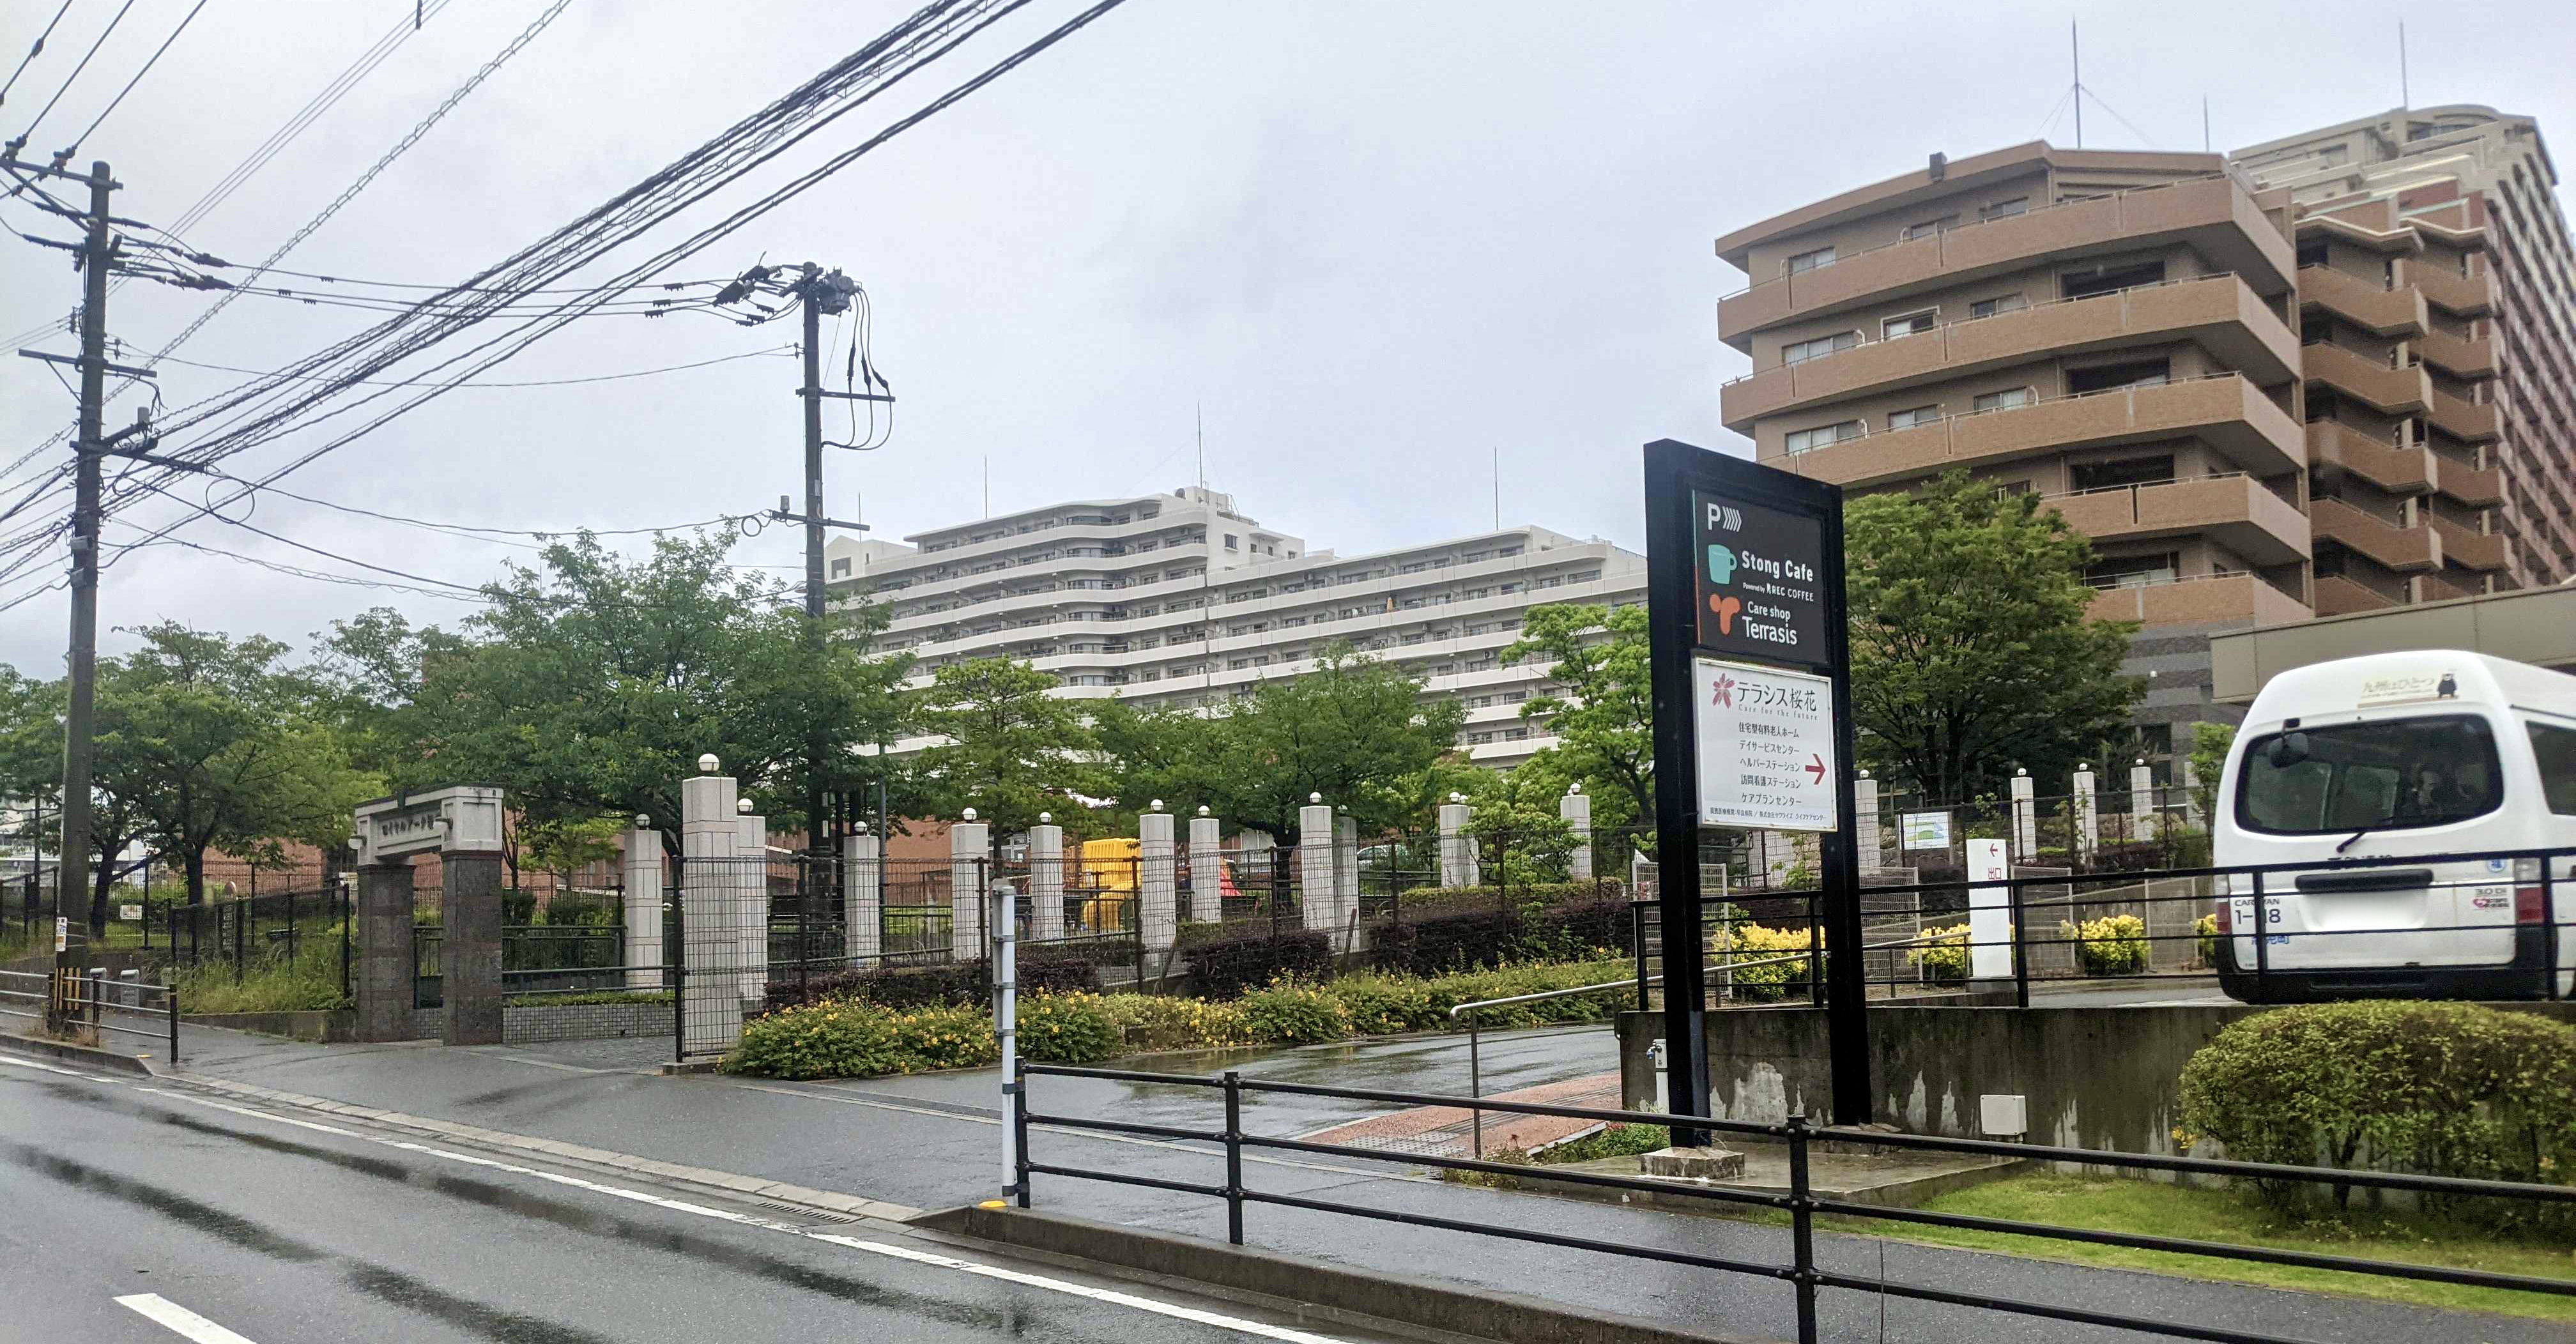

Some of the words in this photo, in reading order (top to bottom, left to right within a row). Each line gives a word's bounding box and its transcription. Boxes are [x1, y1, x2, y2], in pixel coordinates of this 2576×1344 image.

[1707, 502, 1721, 530] P
[1742, 550, 1780, 579] Stong
[1785, 560, 1814, 582] Cafe
[1742, 582, 1760, 592] Powered
[1760, 584, 1765, 594] by
[1788, 588, 1814, 602] COFFEE
[1747, 601, 1768, 615] Care
[1769, 606, 1791, 622] shop
[1742, 615, 1797, 645] Terrasis
[1737, 682, 1817, 712] テラシス桜花
[1738, 704, 1756, 712] Care
[1761, 705, 1773, 715] for
[1777, 708, 1790, 717] the
[1793, 711, 1818, 721] future
[1738, 722, 1799, 738] 住宅型有料老人ホーム
[1739, 740, 1800, 754] デイサービスセンター
[1740, 758, 1800, 772] ヘルパーステーション
[1740, 774, 1802, 789] 訪問看護ステーション
[1741, 793, 1802, 806] ケアプランセンター
